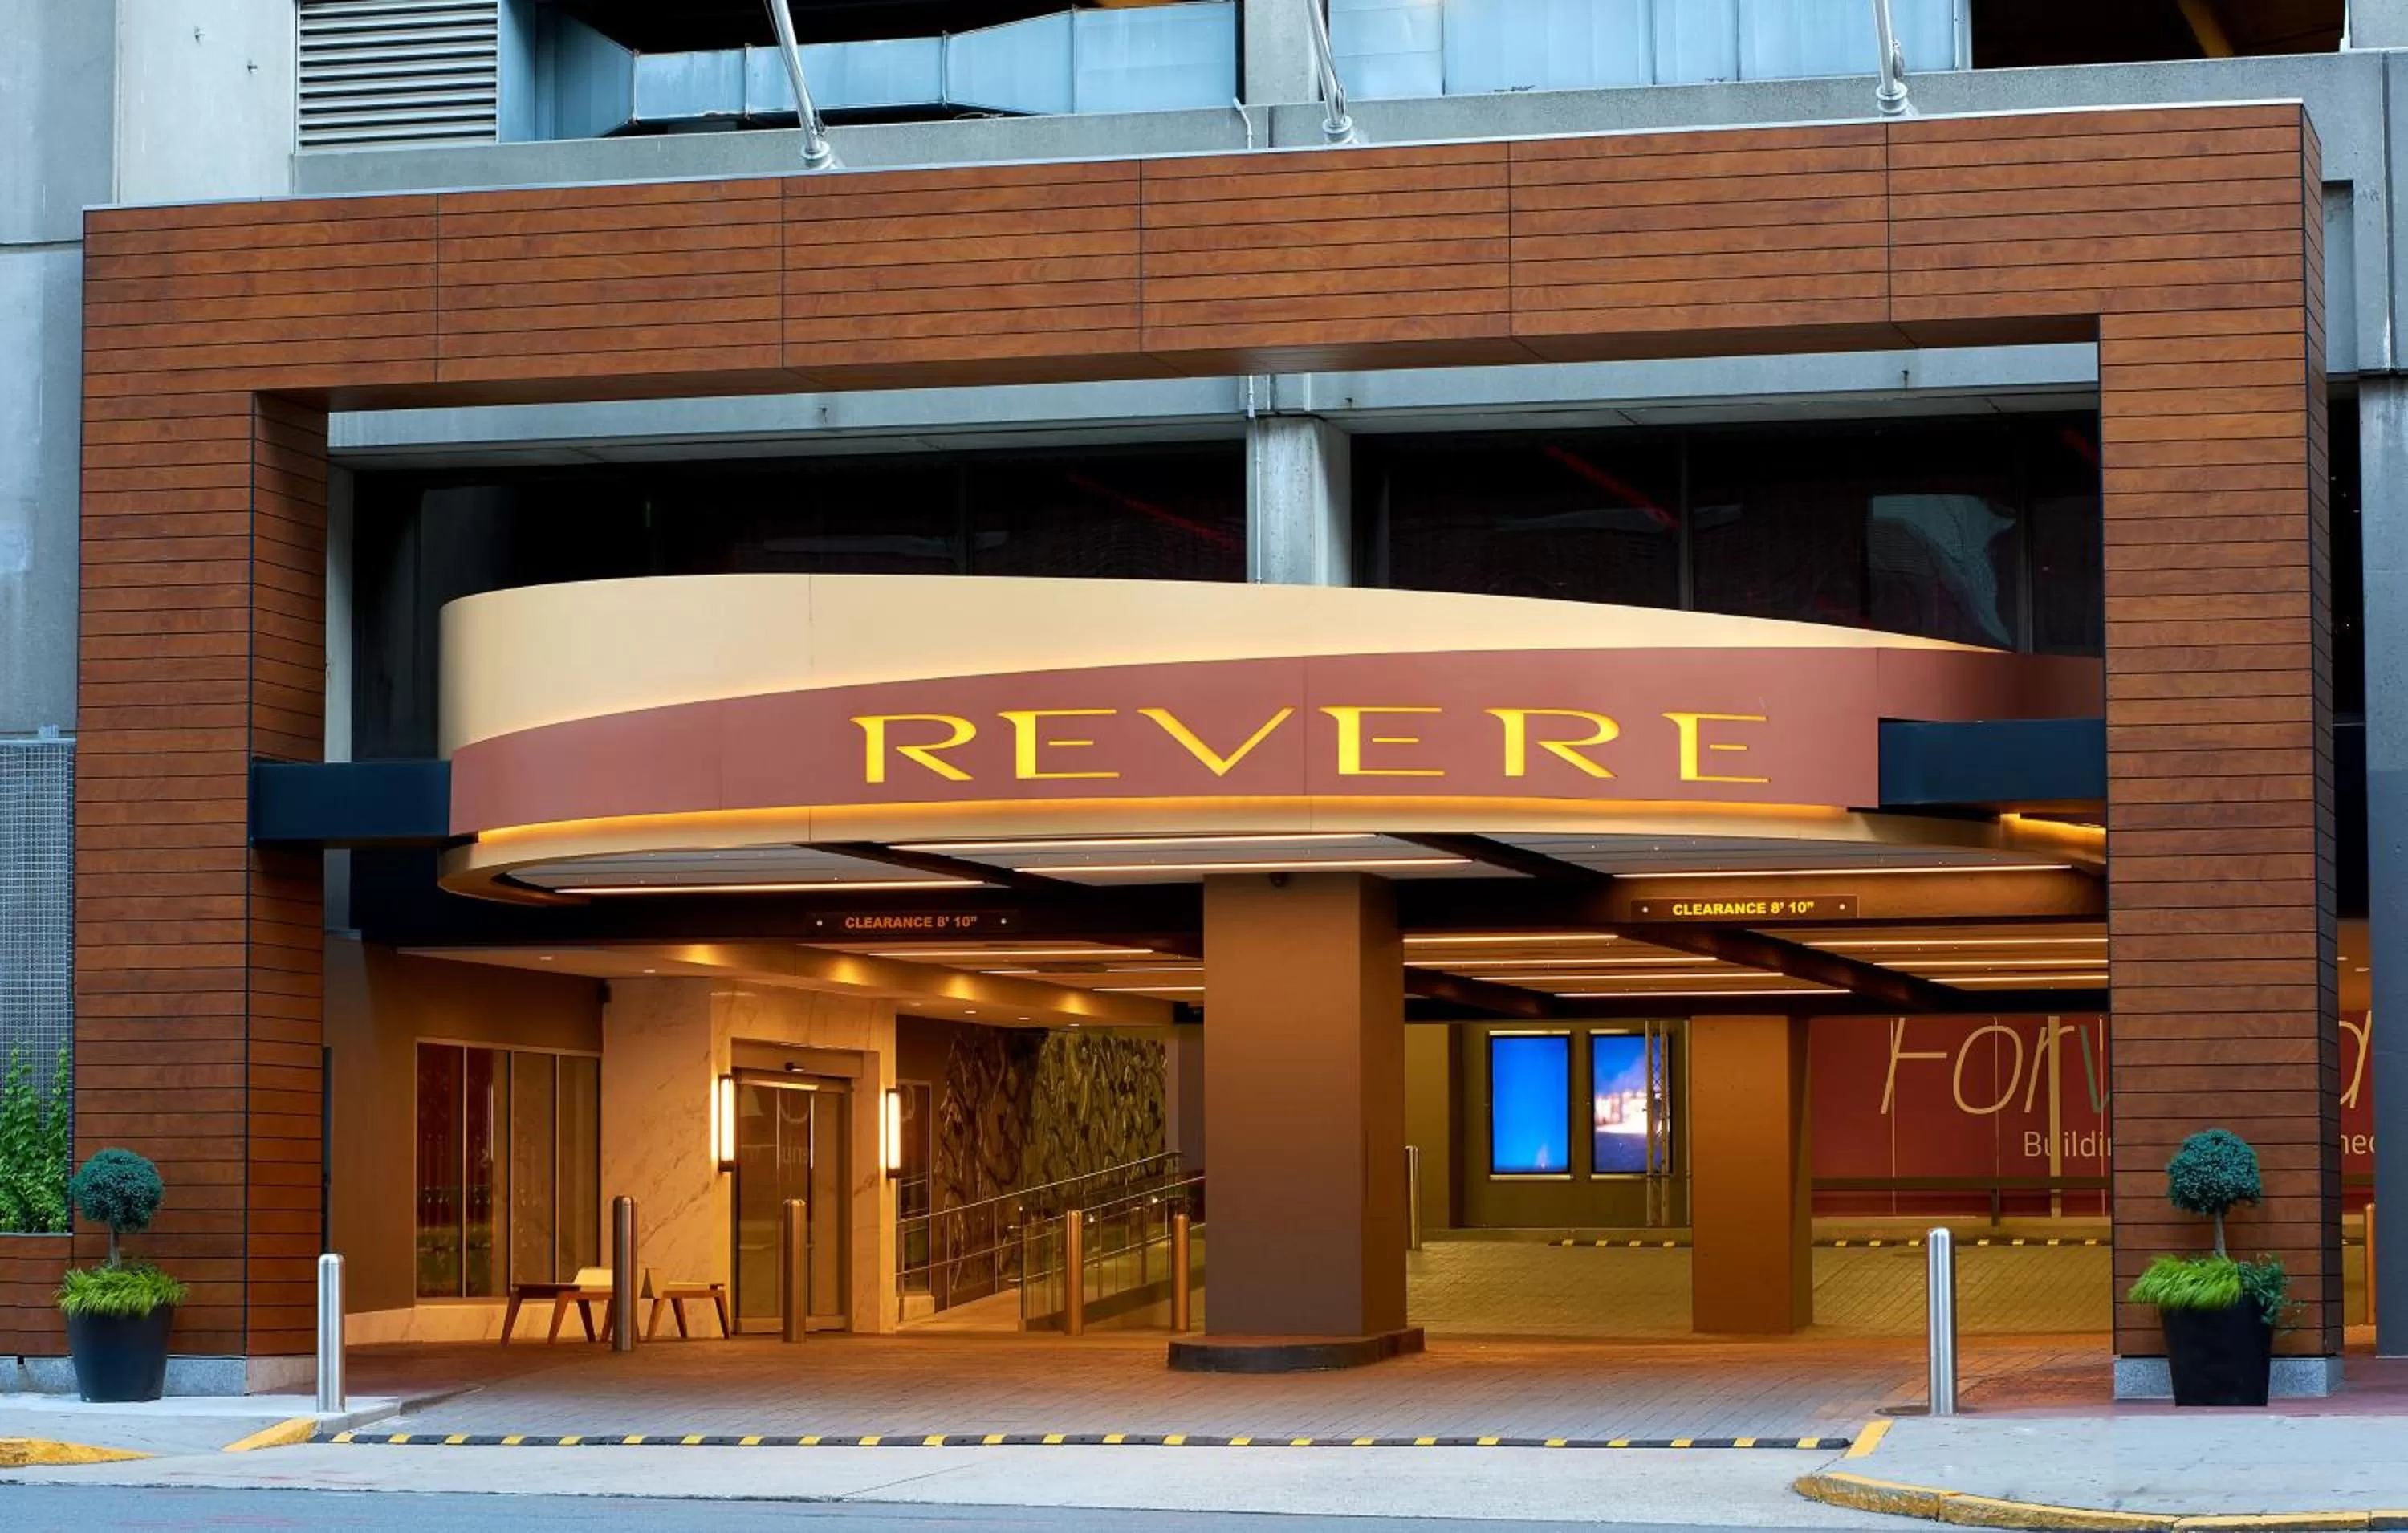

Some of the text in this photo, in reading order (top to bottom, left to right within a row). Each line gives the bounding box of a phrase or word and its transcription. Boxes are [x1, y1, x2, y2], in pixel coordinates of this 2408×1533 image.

[850, 706, 1771, 784] REVERE
[1672, 900, 1815, 916] CLEARANCE 8' 10"
[844, 915, 978, 929] CLEARANCE 8' 10"
